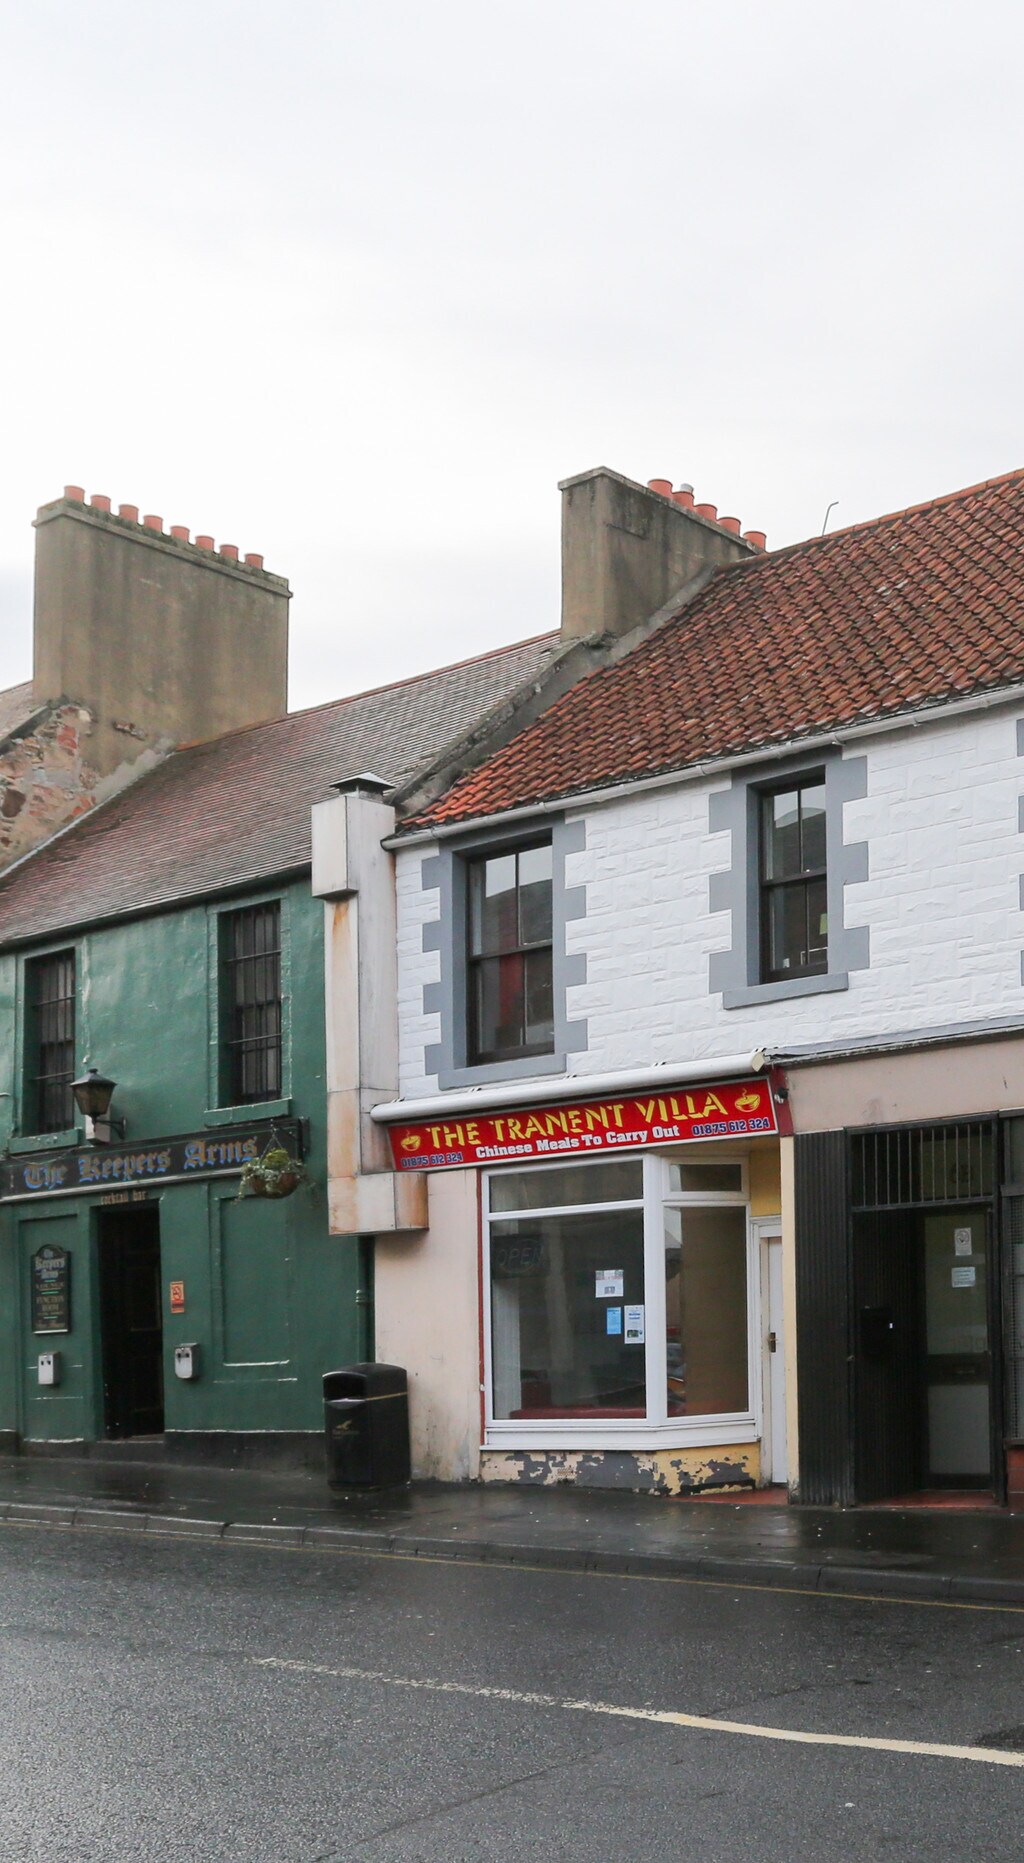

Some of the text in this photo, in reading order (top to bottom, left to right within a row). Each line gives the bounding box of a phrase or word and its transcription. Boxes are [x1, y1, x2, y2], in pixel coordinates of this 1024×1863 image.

[427, 1092, 729, 1149] THE TRANENT VILLA
[692, 1117, 770, 1136] 01875 612 324
[475, 1125, 680, 1159] Chinese Meals To Carry Out
[23, 1164, 68, 1191] The
[184, 1137, 258, 1170] Arms
[400, 1151, 463, 1169] 01875 612 324
